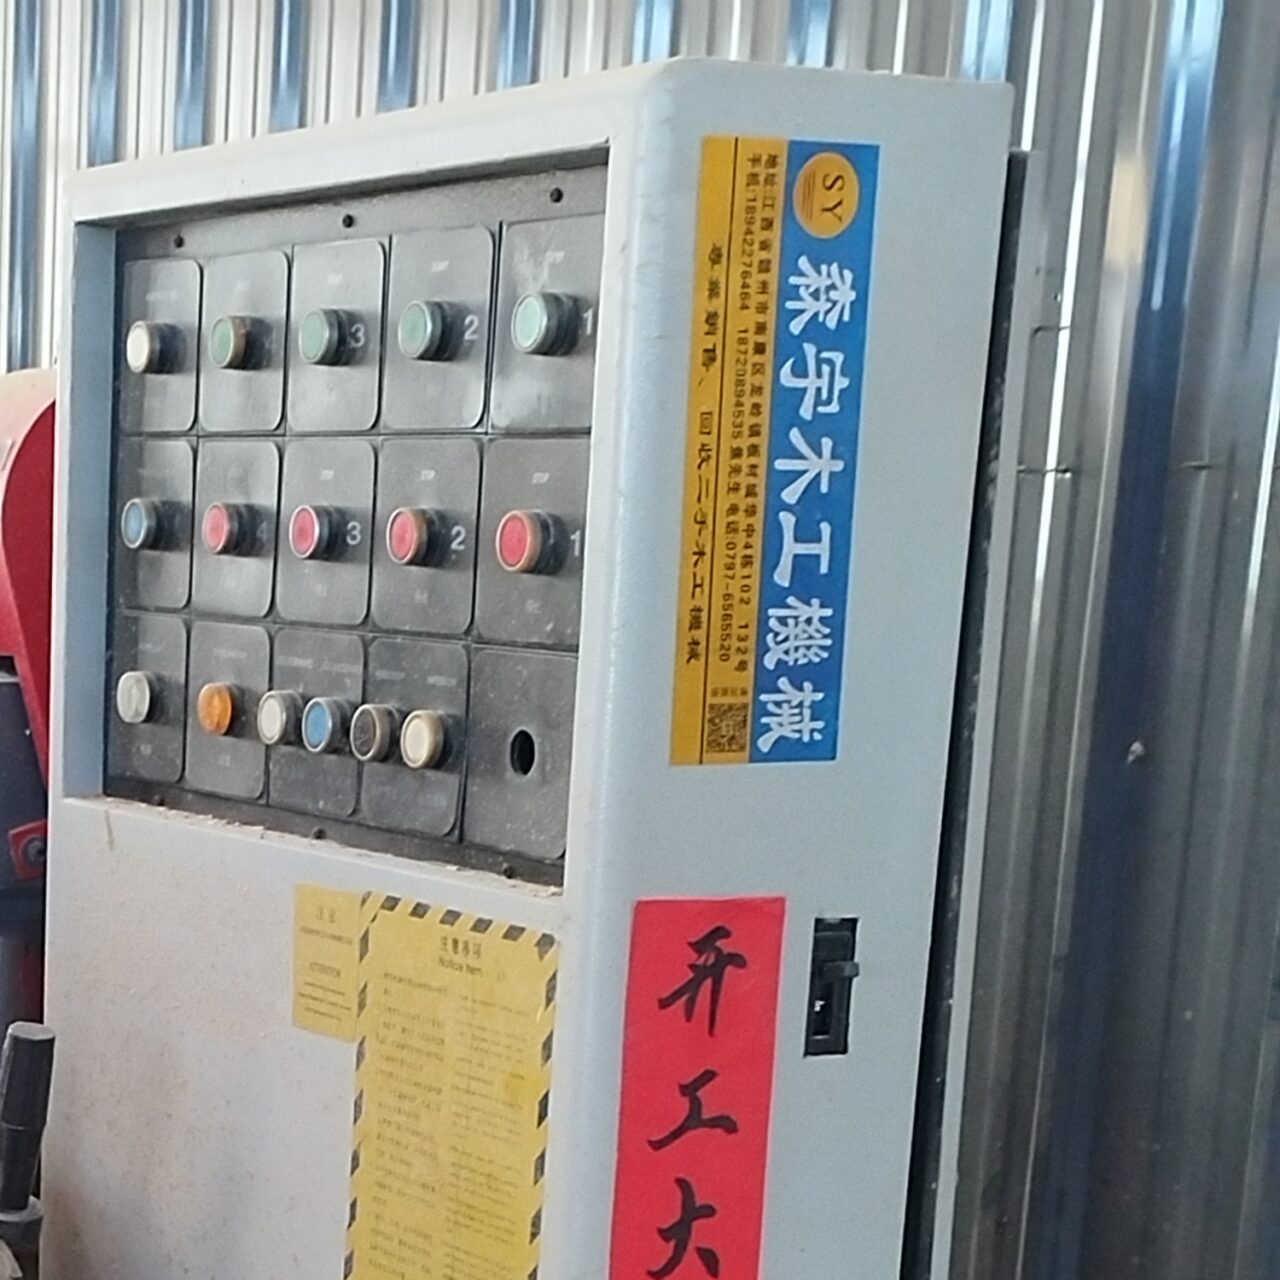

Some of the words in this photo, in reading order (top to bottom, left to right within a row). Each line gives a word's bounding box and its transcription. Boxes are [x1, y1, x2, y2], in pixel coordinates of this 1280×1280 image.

[821, 173, 845, 223] SY
[350, 324, 365, 347] 3
[464, 315, 479, 340] 2
[583, 309, 593, 335] 1
[755, 254, 859, 753] 森宇木工機械
[346, 521, 362, 545] 3
[451, 526, 466, 550] 2
[571, 530, 581, 556] 1
